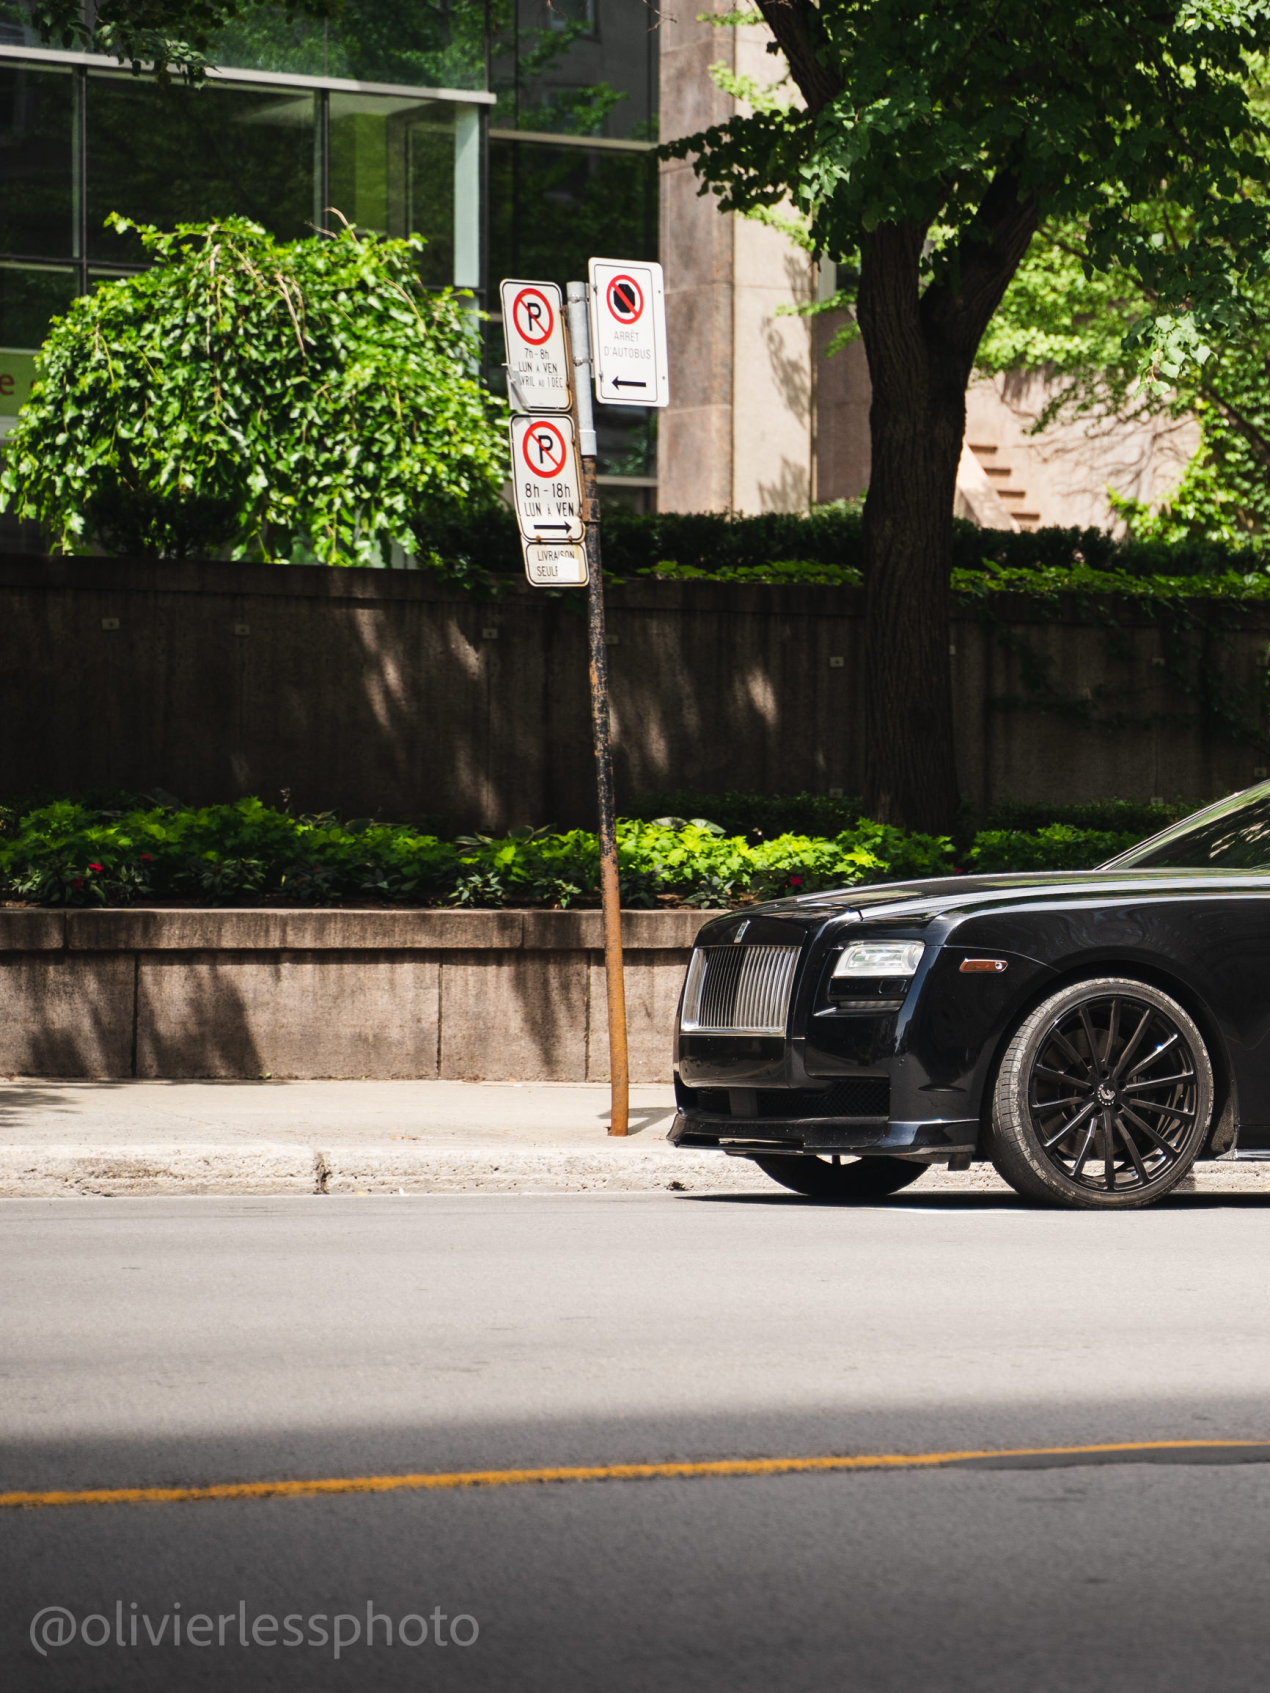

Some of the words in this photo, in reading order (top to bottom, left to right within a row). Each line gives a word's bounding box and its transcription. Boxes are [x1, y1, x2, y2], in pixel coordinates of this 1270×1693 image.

[613, 329, 639, 342] ARRÊT
[603, 345, 651, 360] D'AUTOBUS
[518, 361, 533, 372] LUN
[543, 362, 558, 373] VEN
[520, 375, 535, 387] VRIL
[524, 502, 542, 517] LUN
[556, 502, 575, 517] VEN
